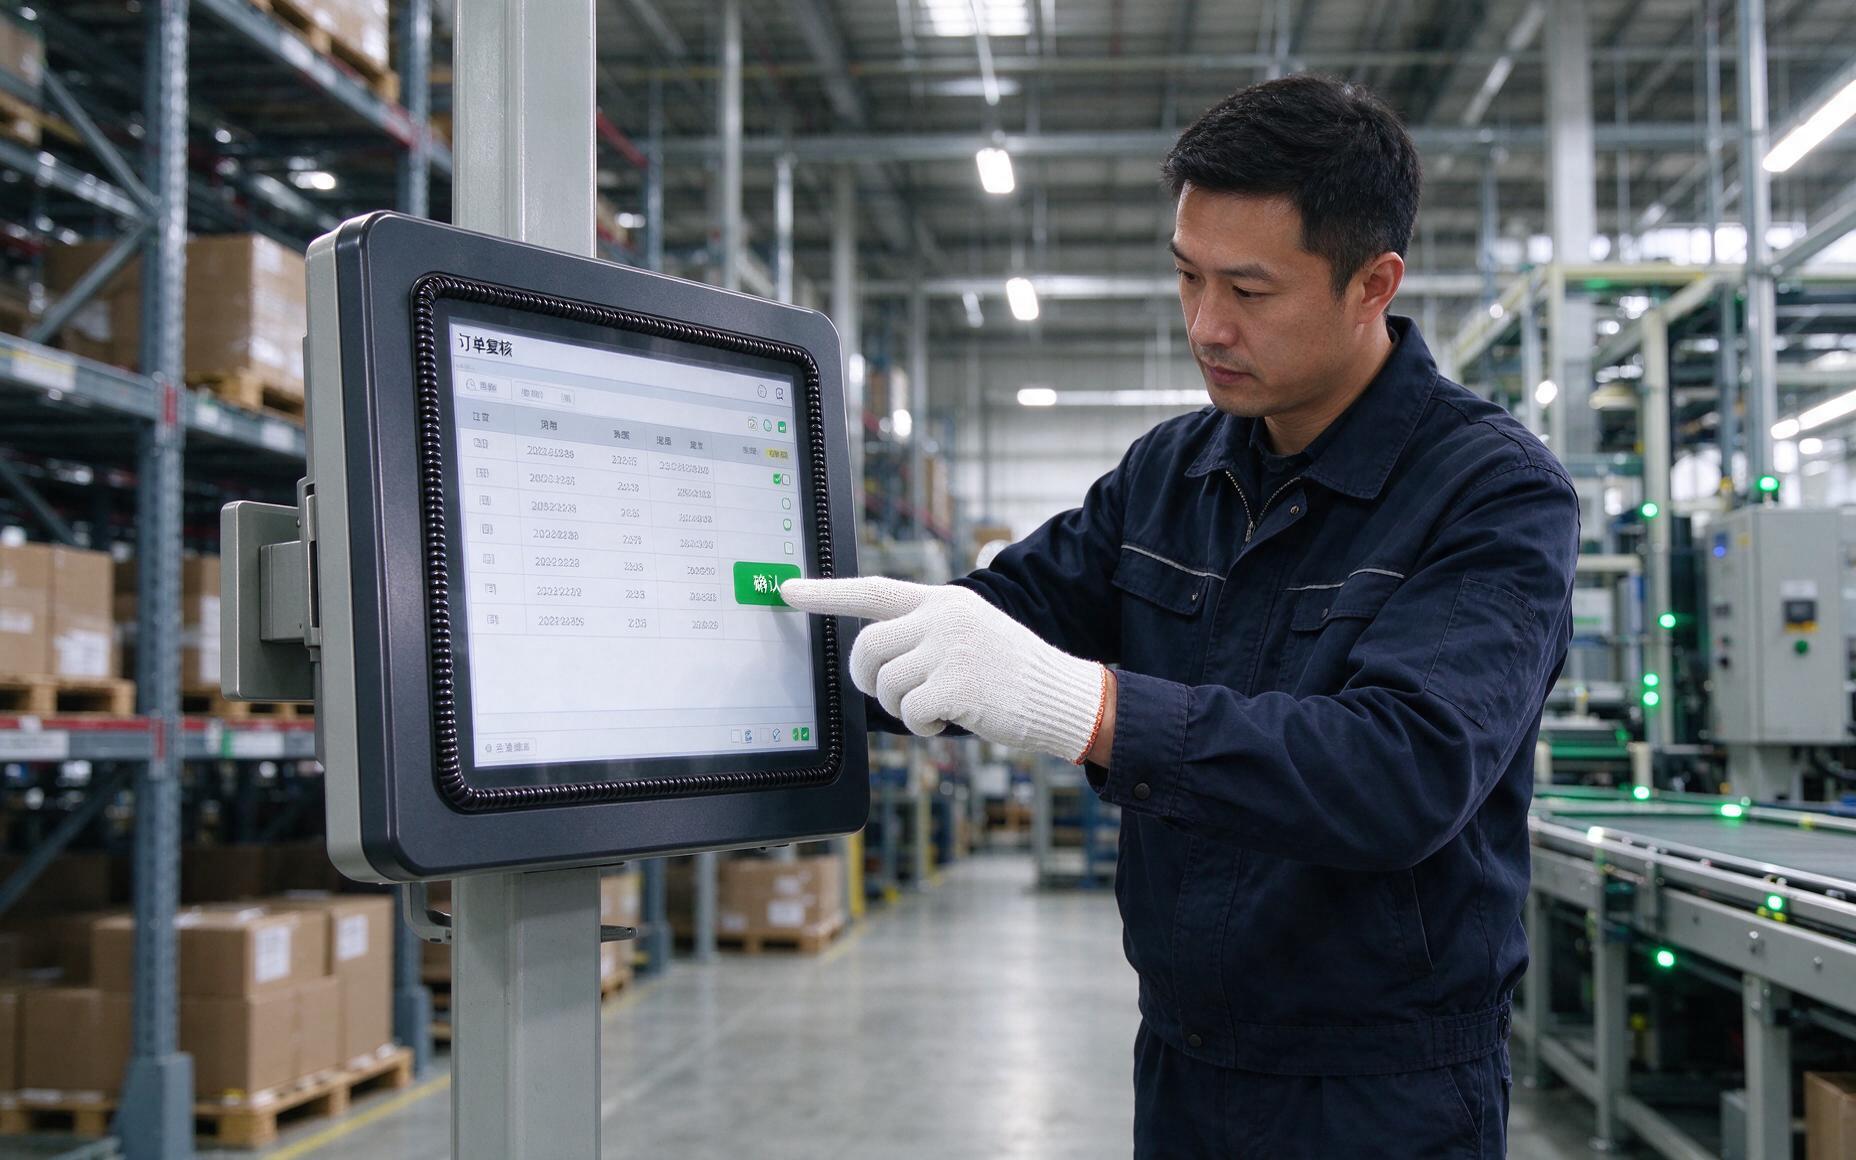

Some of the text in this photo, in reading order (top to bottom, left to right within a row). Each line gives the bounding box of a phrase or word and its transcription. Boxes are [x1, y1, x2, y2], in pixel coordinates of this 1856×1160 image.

[459, 333, 513, 357] 订单复核
[752, 573, 781, 593] 确认
